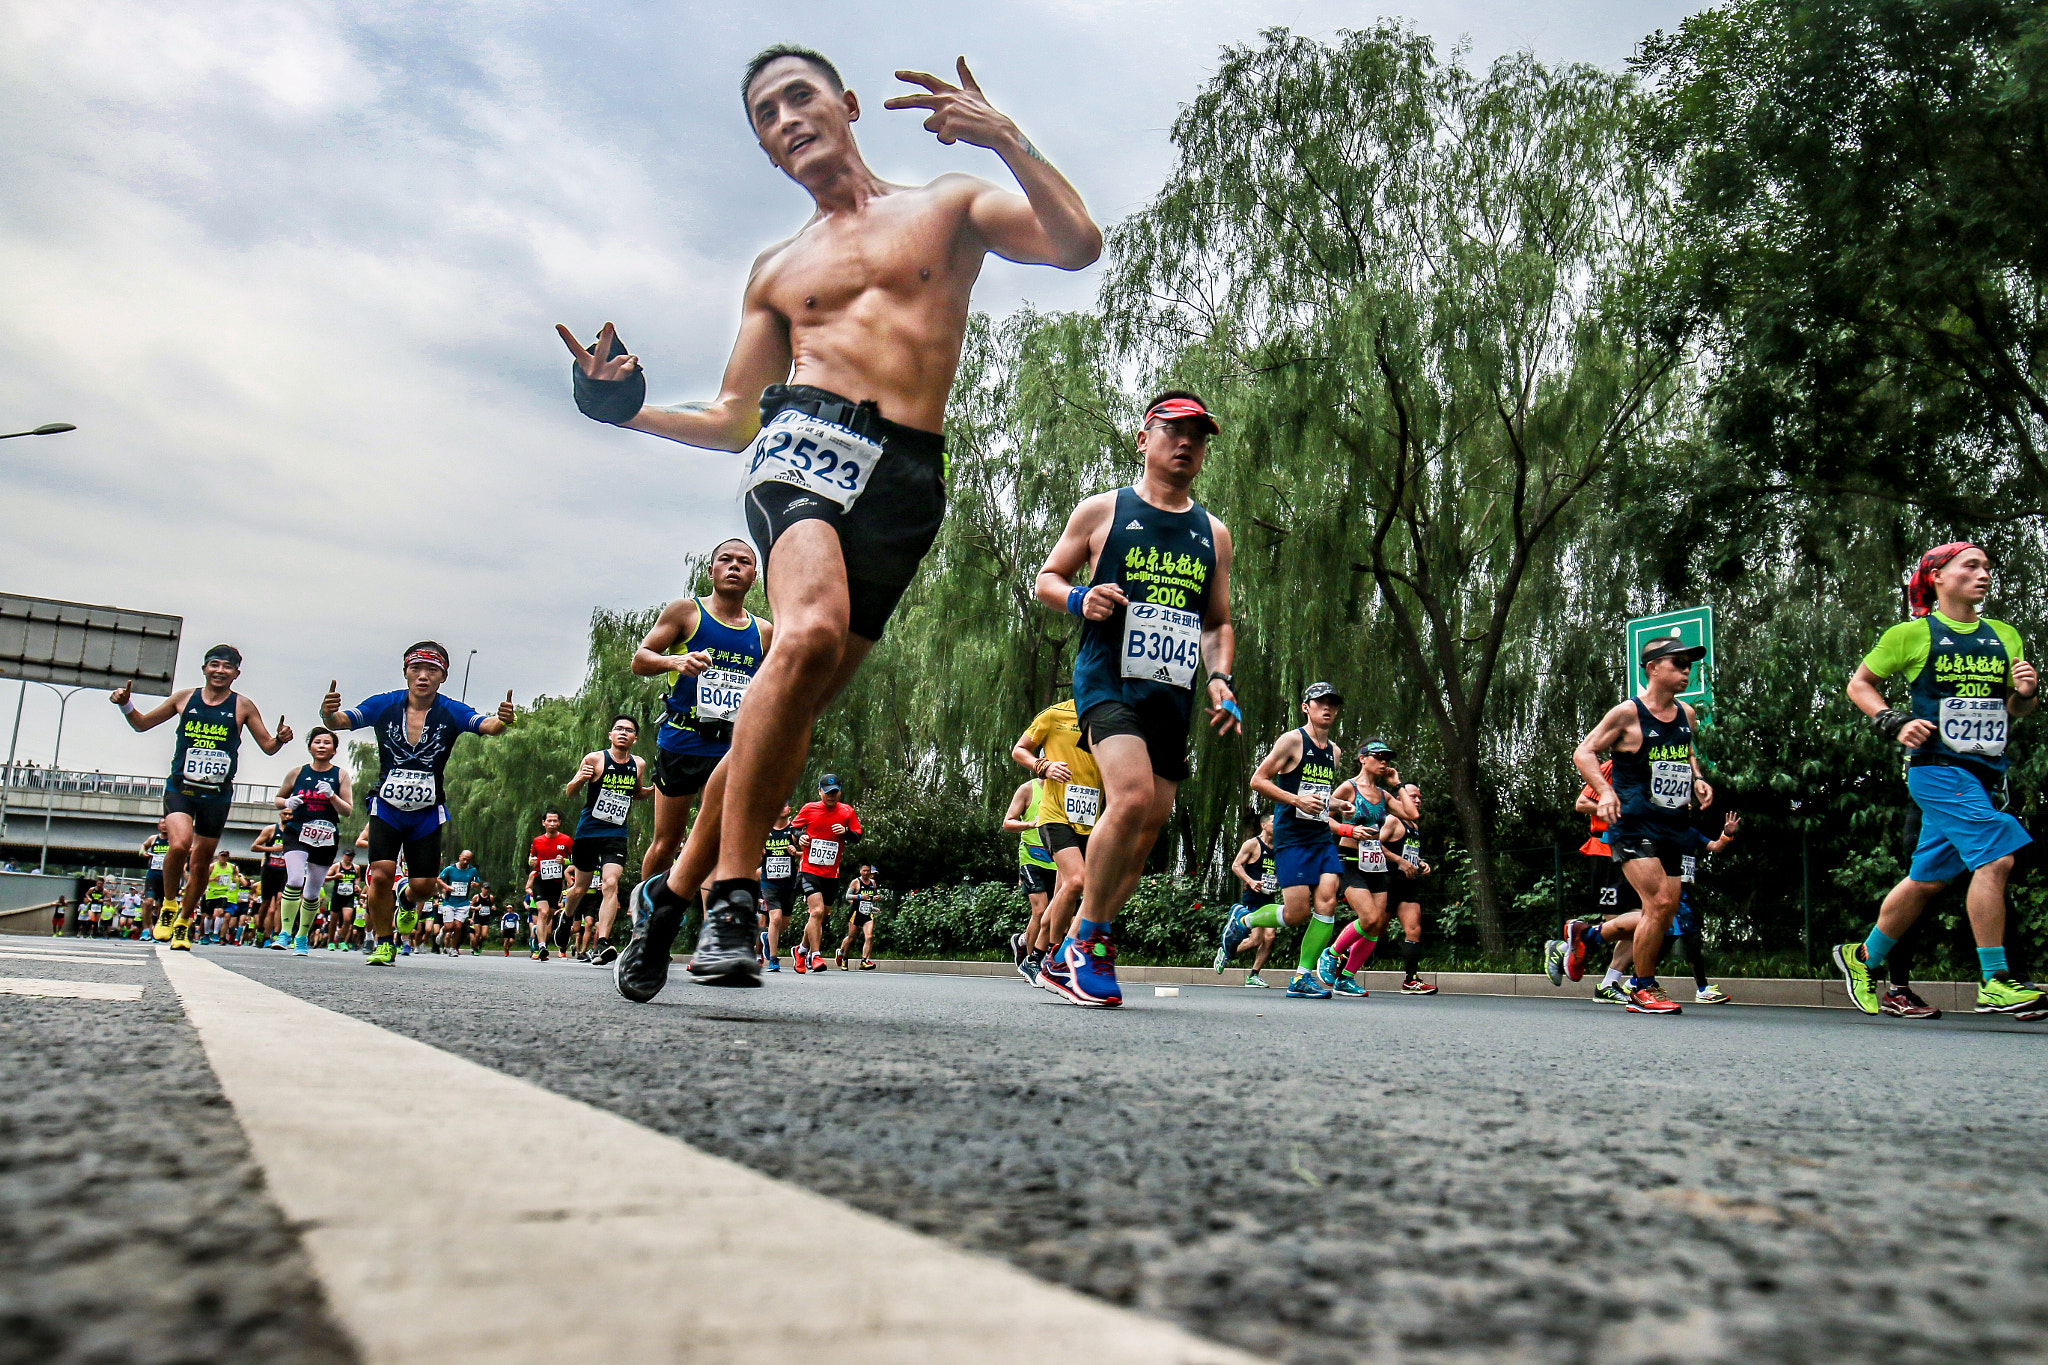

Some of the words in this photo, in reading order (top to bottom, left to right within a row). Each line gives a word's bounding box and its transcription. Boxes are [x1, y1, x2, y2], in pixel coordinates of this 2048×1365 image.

[750, 431, 860, 490] B2523
[775, 473, 812, 488] adidas
[1125, 546, 1207, 583] 北京马拉松
[1126, 571, 1160, 583] beijing
[1161, 575, 1202, 594] marathon
[1146, 584, 1186, 608] 2016
[1127, 630, 1198, 669] B3045
[1935, 653, 2005, 675] 北京马拉松
[1936, 674, 1967, 683] beijing
[701, 687, 741, 709] B046
[1955, 682, 1992, 697] 2016
[1945, 719, 2005, 741] C2132
[193, 739, 216, 749] 2016
[187, 760, 227, 776] B1655
[383, 783, 432, 803] B3232
[1654, 777, 1690, 797] B2247
[597, 800, 627, 818] B3856
[1067, 798, 1097, 816] B0343
[811, 847, 837, 860] B0755
[542, 866, 561, 875] C1123
[767, 864, 789, 873] C3672
[1600, 887, 1618, 905] 23
